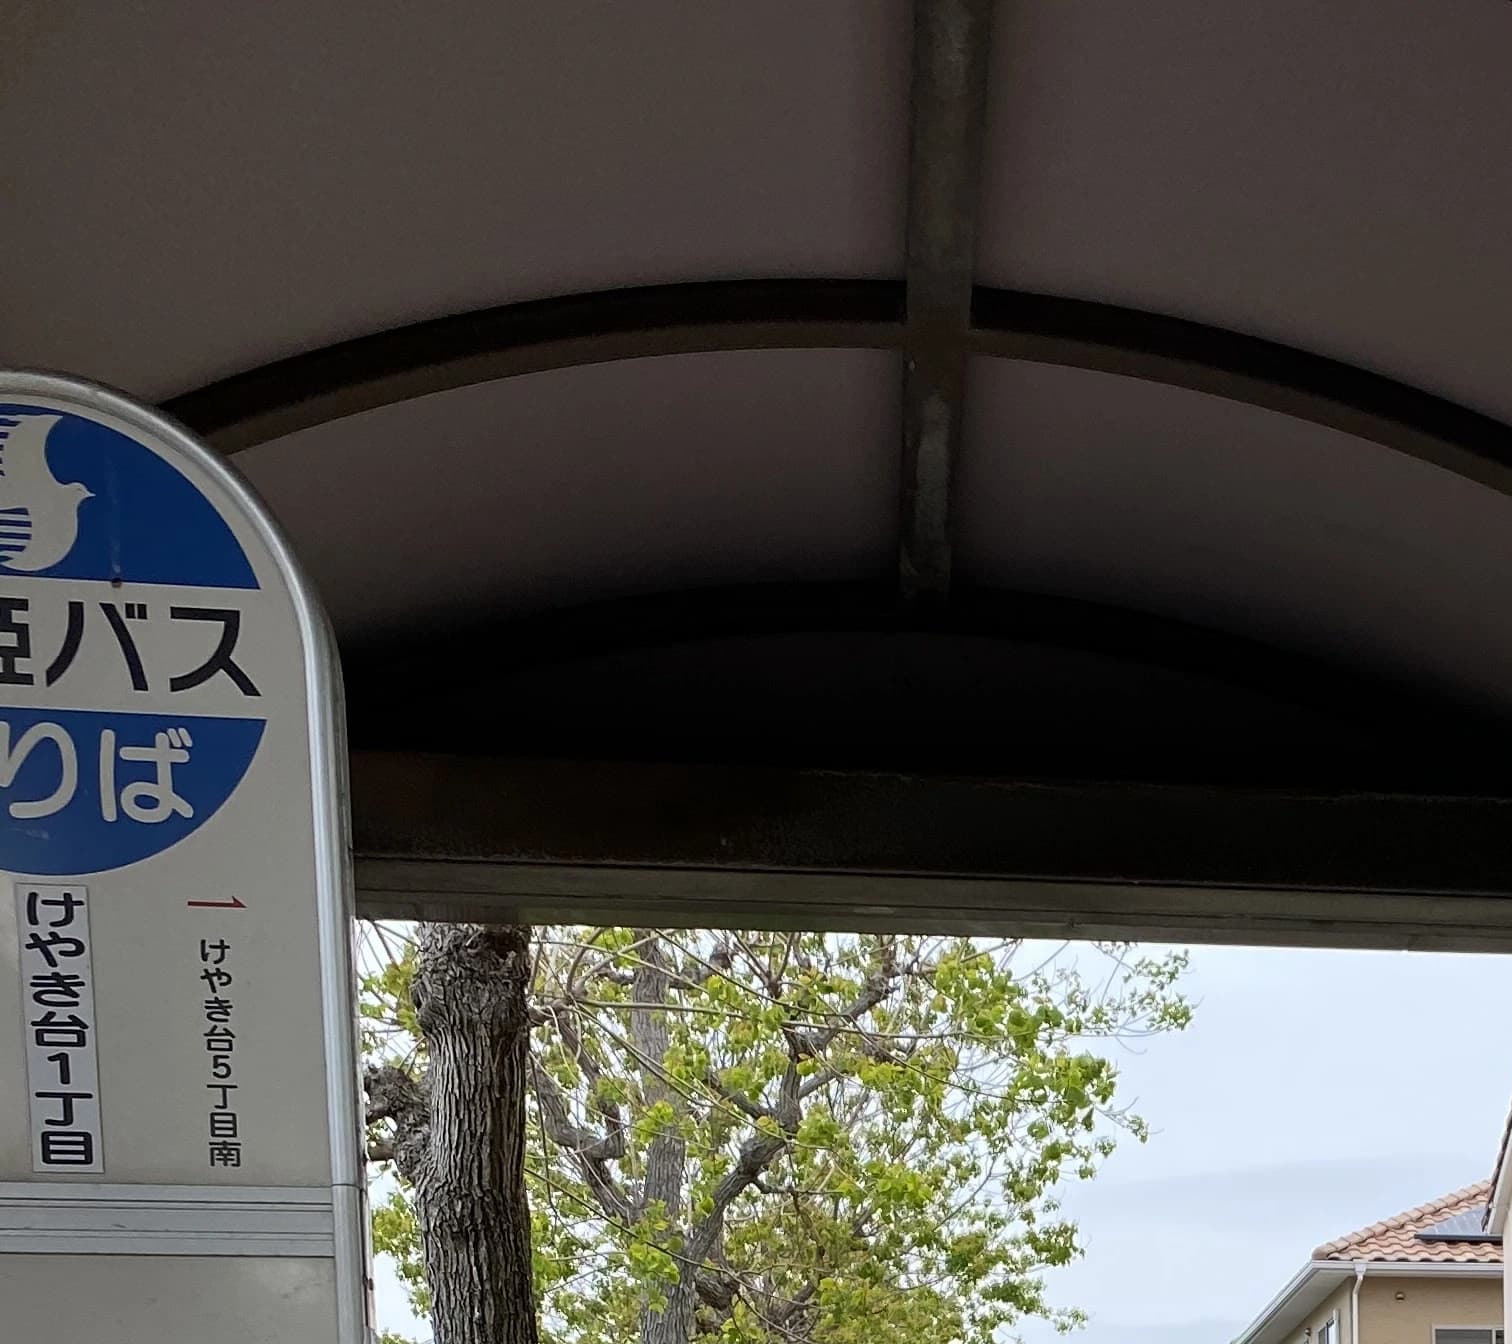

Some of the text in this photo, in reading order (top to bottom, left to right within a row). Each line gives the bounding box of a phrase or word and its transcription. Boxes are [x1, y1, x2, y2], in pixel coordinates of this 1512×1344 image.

[25, 892, 93, 1165] けやき台1丁目
[200, 939, 241, 1167] けやき台5丁目南
